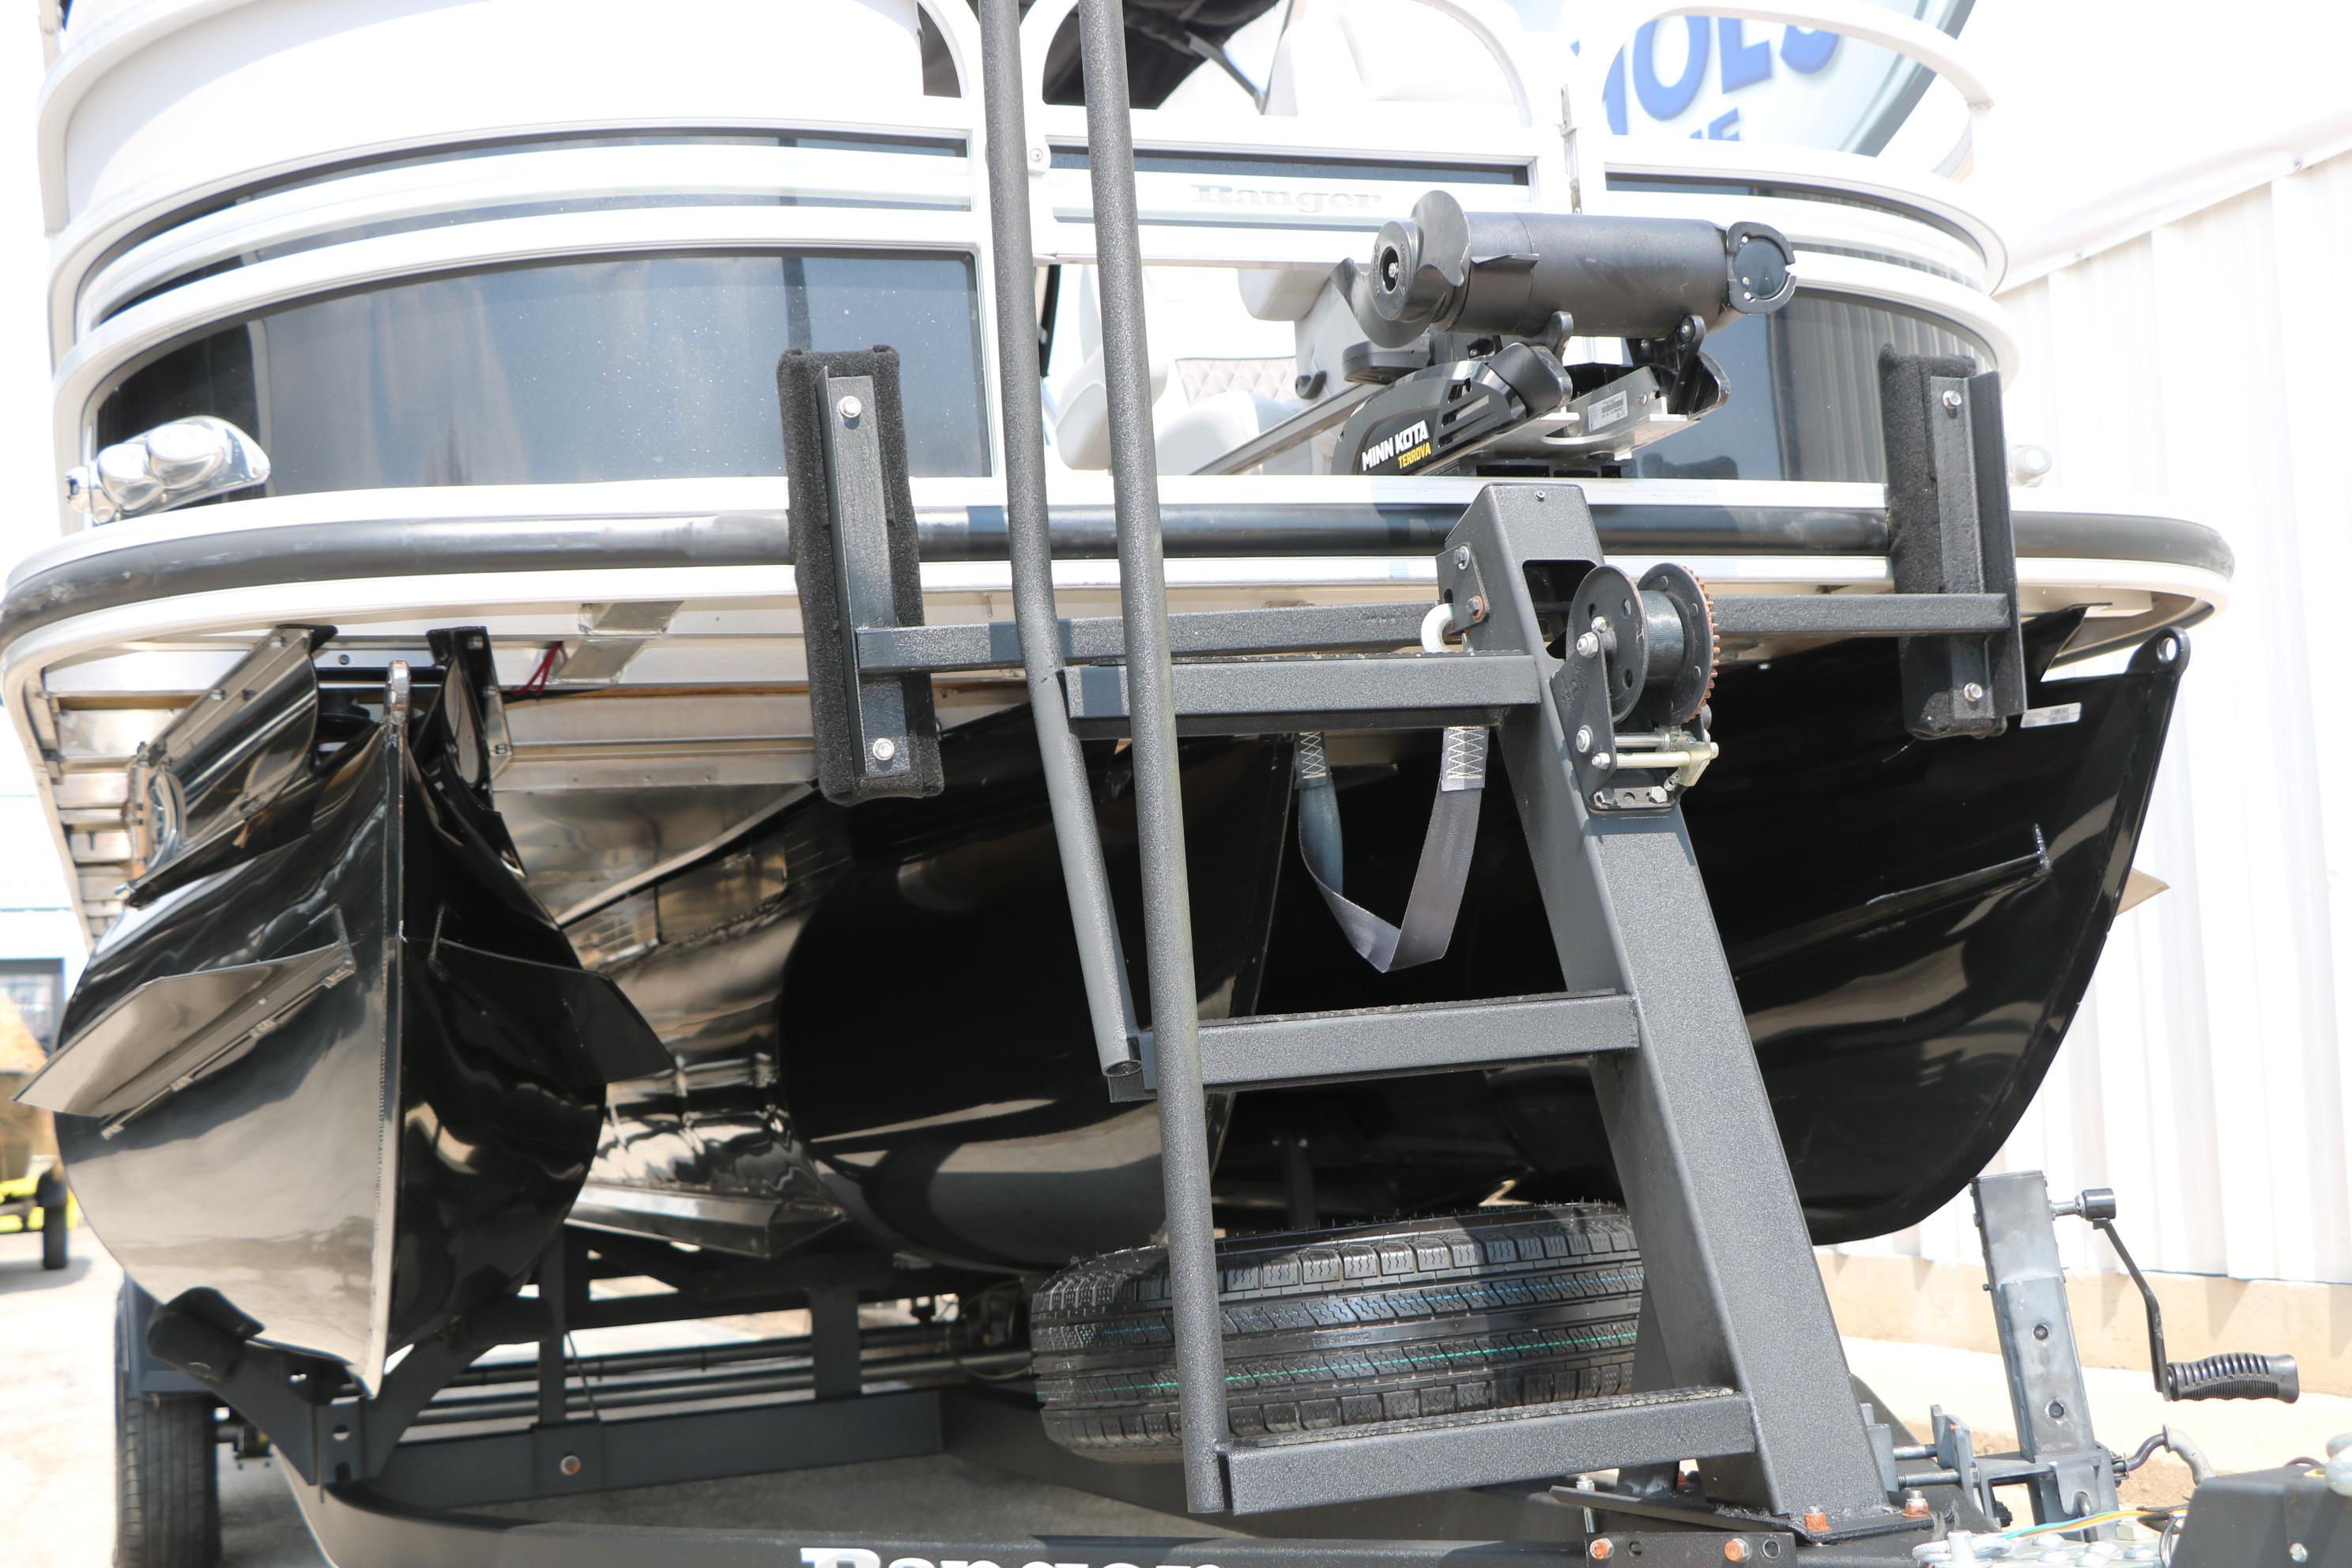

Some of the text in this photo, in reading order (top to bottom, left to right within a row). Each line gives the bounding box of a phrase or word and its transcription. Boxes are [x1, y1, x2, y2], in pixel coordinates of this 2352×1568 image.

[1191, 184, 1382, 213] Ranger
[1362, 420, 1430, 472] MINN KOTA
[1398, 442, 1432, 469] TERROVA
